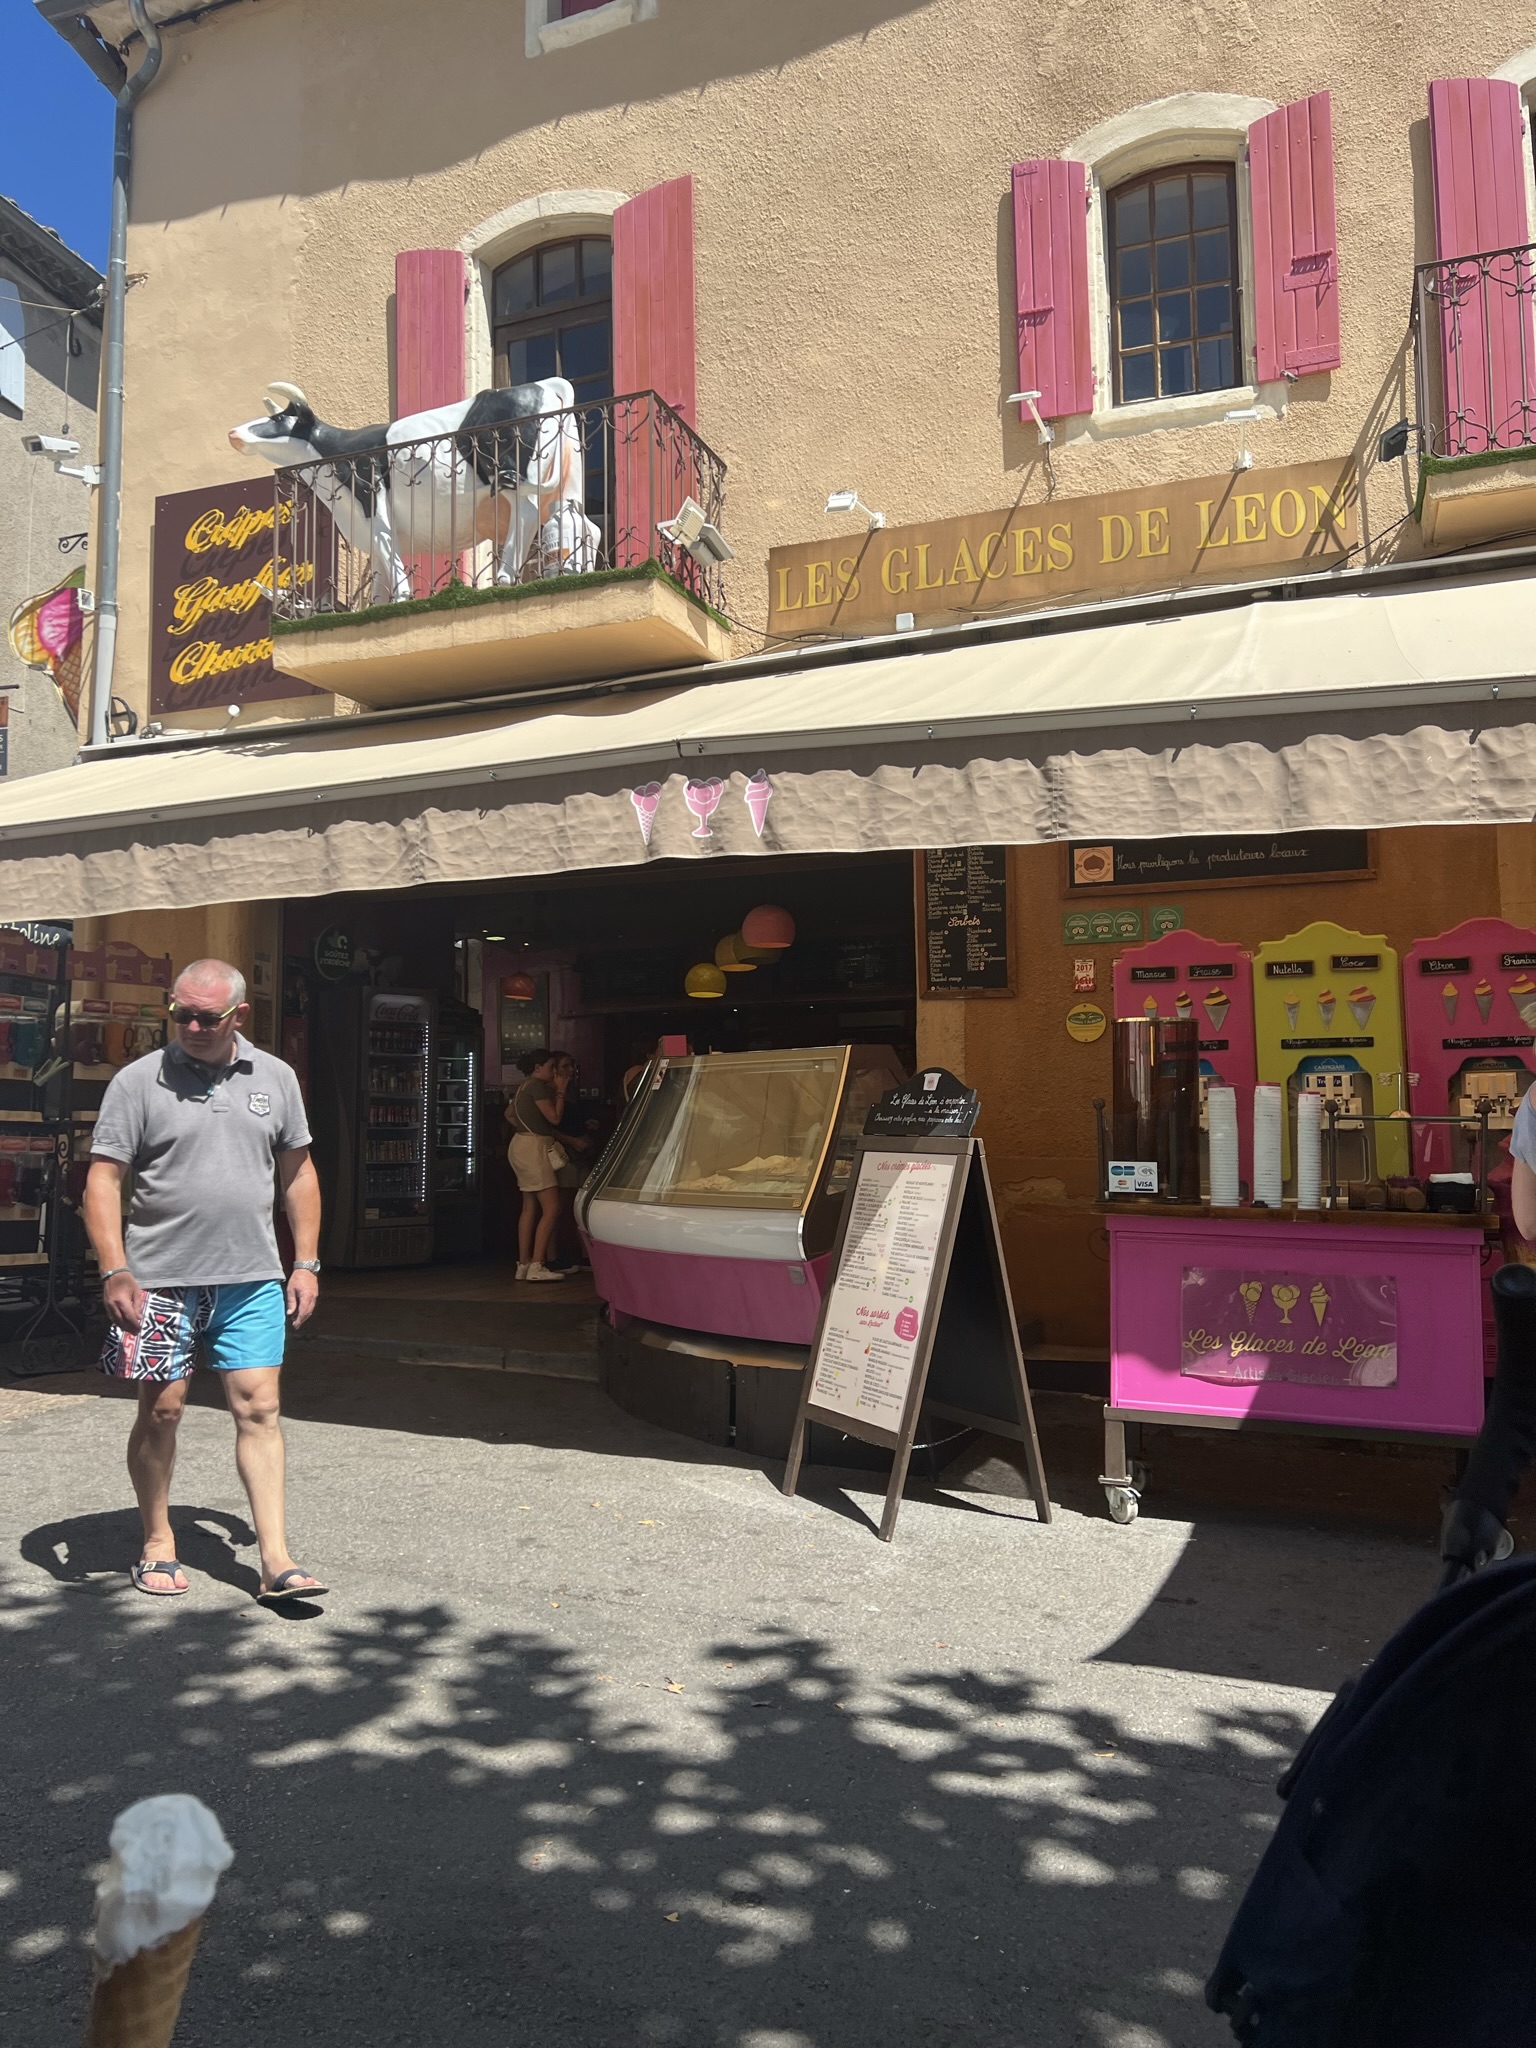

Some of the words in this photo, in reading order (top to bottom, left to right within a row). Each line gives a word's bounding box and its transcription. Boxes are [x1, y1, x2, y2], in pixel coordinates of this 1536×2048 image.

[776, 556, 860, 612] LES
[881, 522, 1073, 594] GLACES
[1099, 507, 1170, 564] DE
[1195, 480, 1349, 550] LEON
[1206, 848, 1265, 870] producteurs
[947, 914, 981, 927] Sorbets
[1076, 964, 1093, 972] 2017
[1339, 956, 1365, 968] Coco
[1272, 964, 1304, 975] Nutella
[855, 1306, 869, 1317] Nos
[869, 1306, 890, 1320] sorbets
[1182, 1328, 1223, 1354] Les
[1229, 1331, 1295, 1358] Glaces
[1301, 1336, 1327, 1355] de
[1331, 1336, 1392, 1364] Léon
